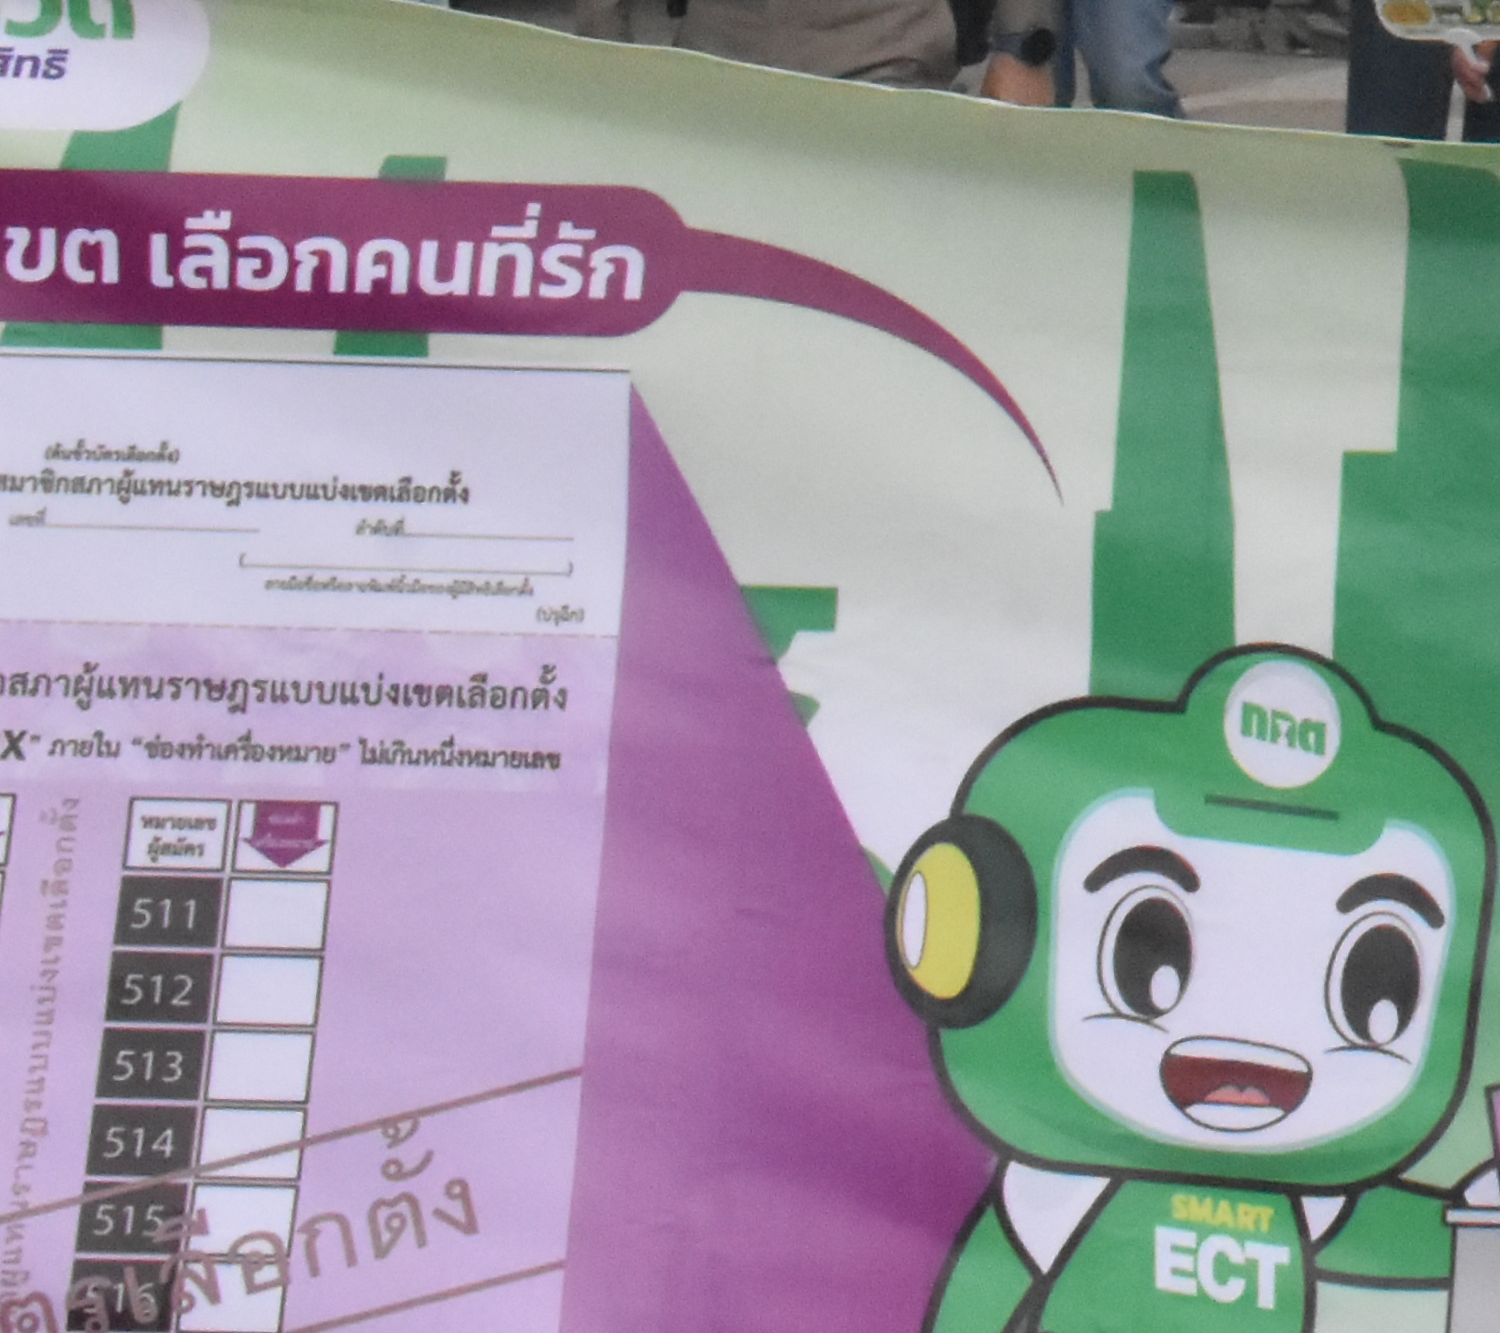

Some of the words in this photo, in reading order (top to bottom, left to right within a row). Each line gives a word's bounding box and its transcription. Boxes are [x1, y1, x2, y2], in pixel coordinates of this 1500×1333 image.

[150, 203, 645, 303] เลือกคนที่รัก
[130, 897, 196, 930] 511
[120, 973, 194, 1006] 512
[112, 1049, 184, 1083] 513
[102, 1126, 175, 1159] 514
[93, 1203, 165, 1237] 515
[1171, 1193, 1275, 1233] SMART
[1153, 1226, 1291, 1311] ECT
